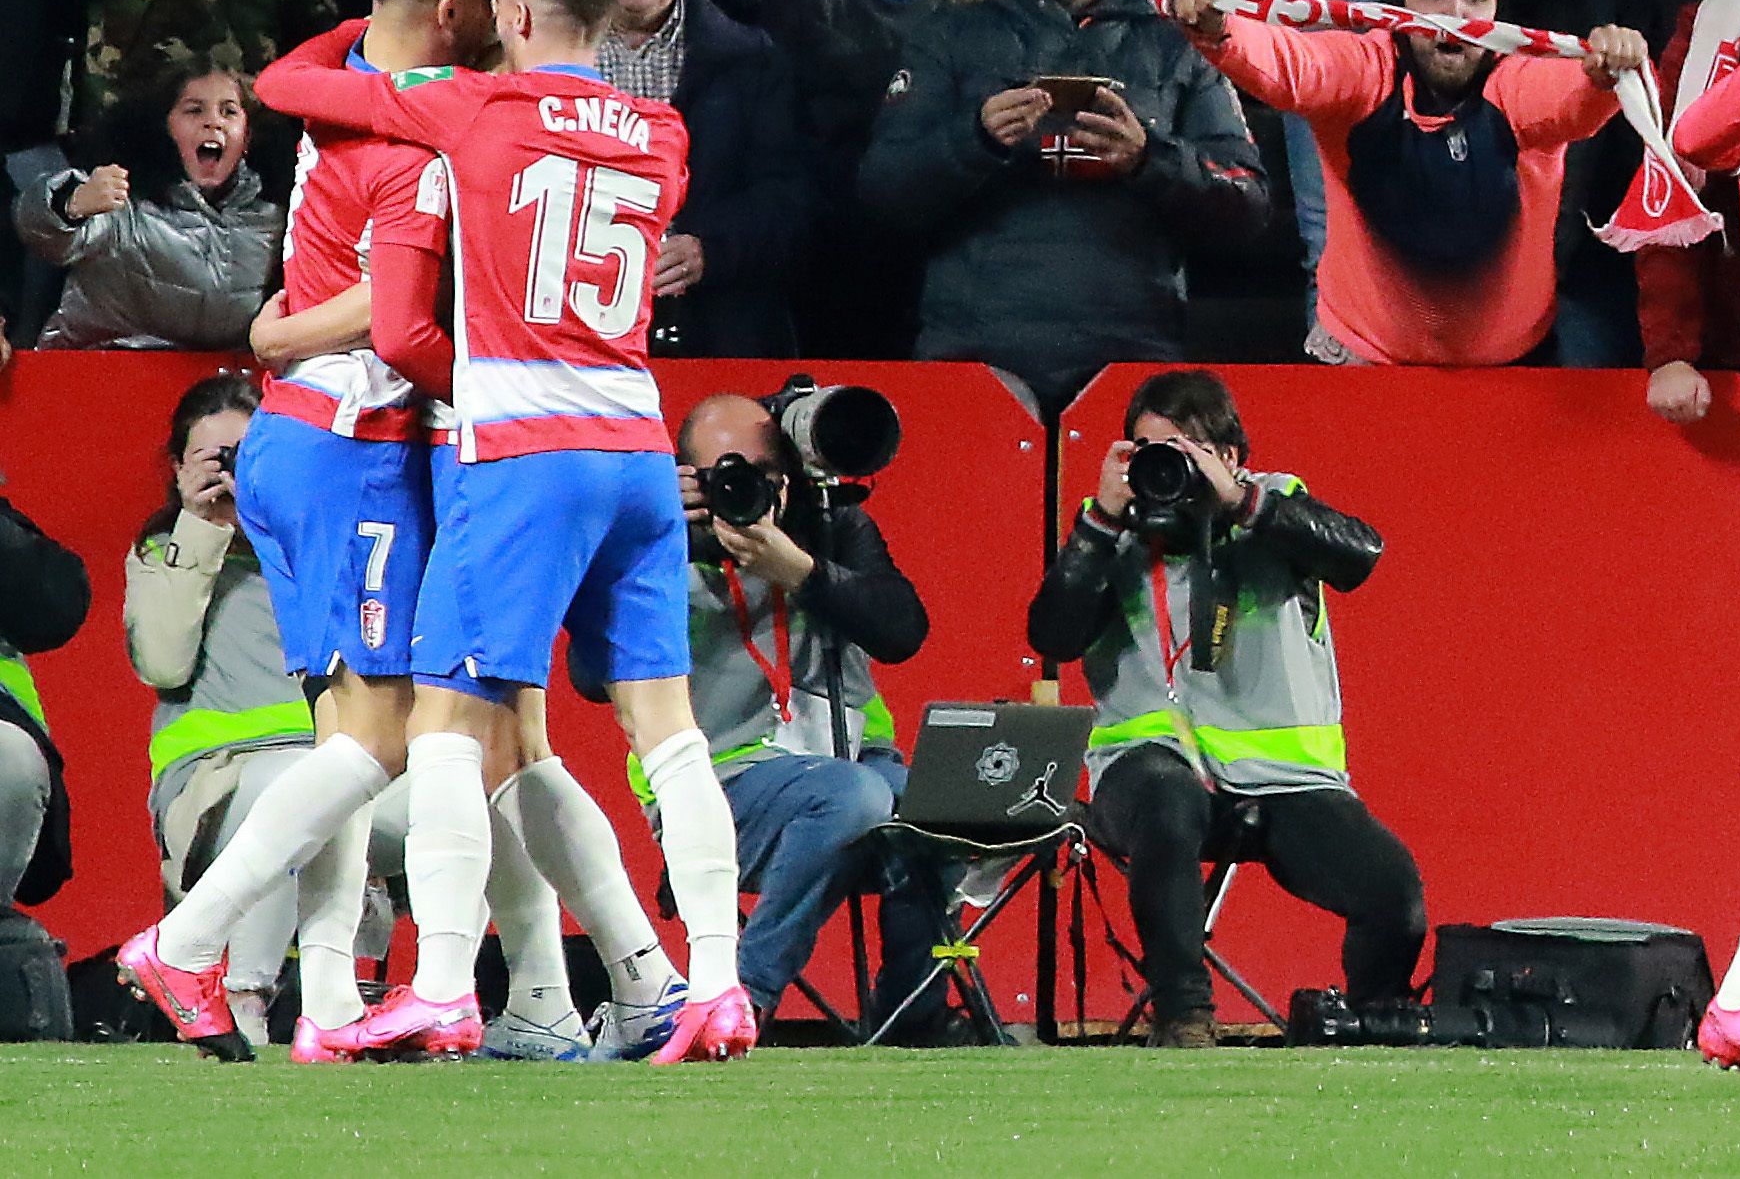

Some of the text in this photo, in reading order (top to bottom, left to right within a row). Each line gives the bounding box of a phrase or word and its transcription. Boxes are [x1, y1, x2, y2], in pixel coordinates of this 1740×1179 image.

[538, 96, 650, 154] C.NEVA
[508, 153, 662, 340] 15
[357, 521, 396, 592] 7
